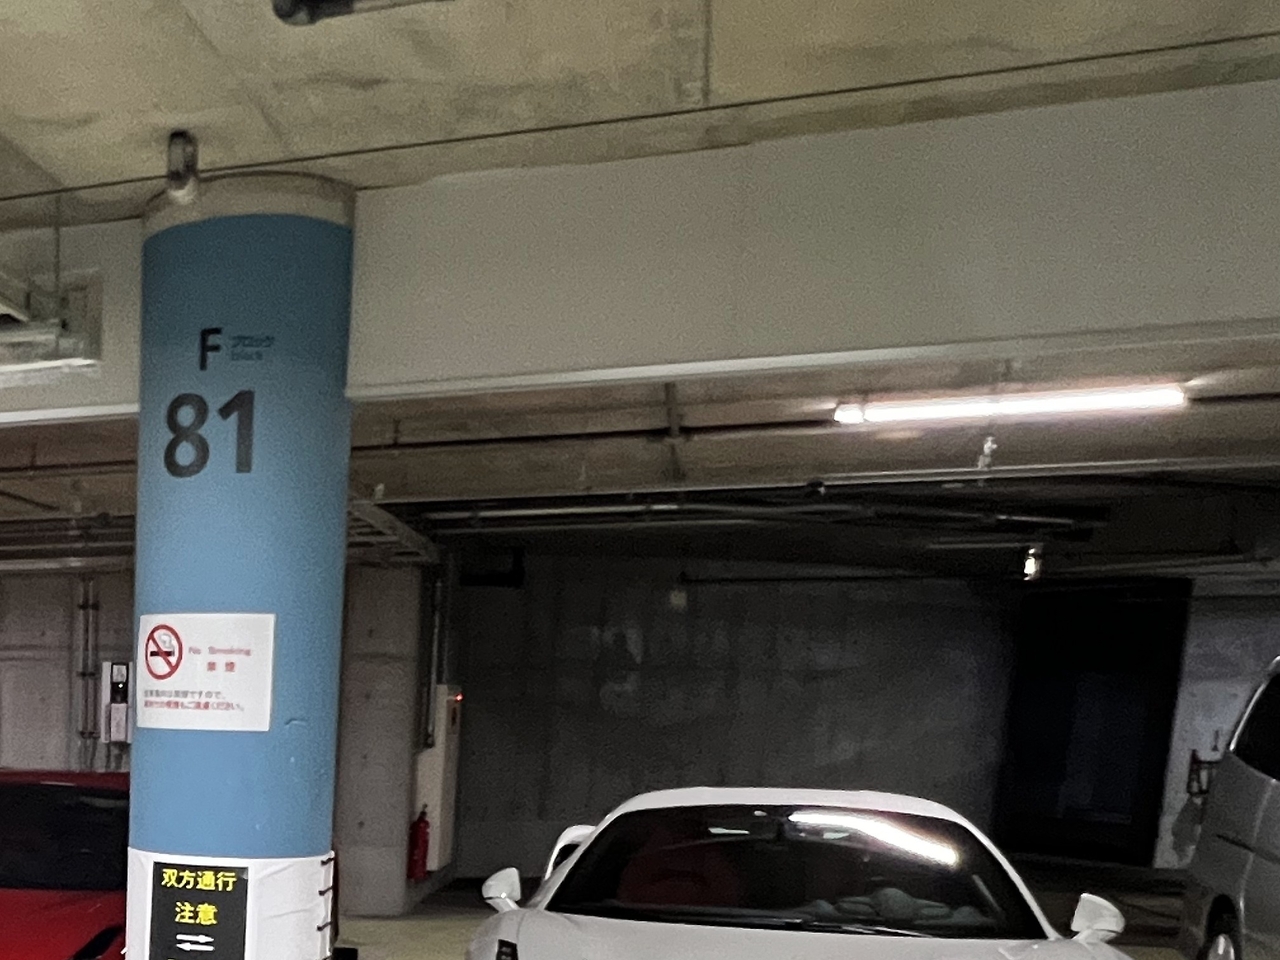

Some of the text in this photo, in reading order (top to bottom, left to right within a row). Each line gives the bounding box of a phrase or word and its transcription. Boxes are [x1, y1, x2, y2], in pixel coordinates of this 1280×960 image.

[199, 328, 223, 371] F
[164, 389, 255, 478] 81
[161, 868, 237, 892] 双方通行
[174, 902, 218, 926] 注意
